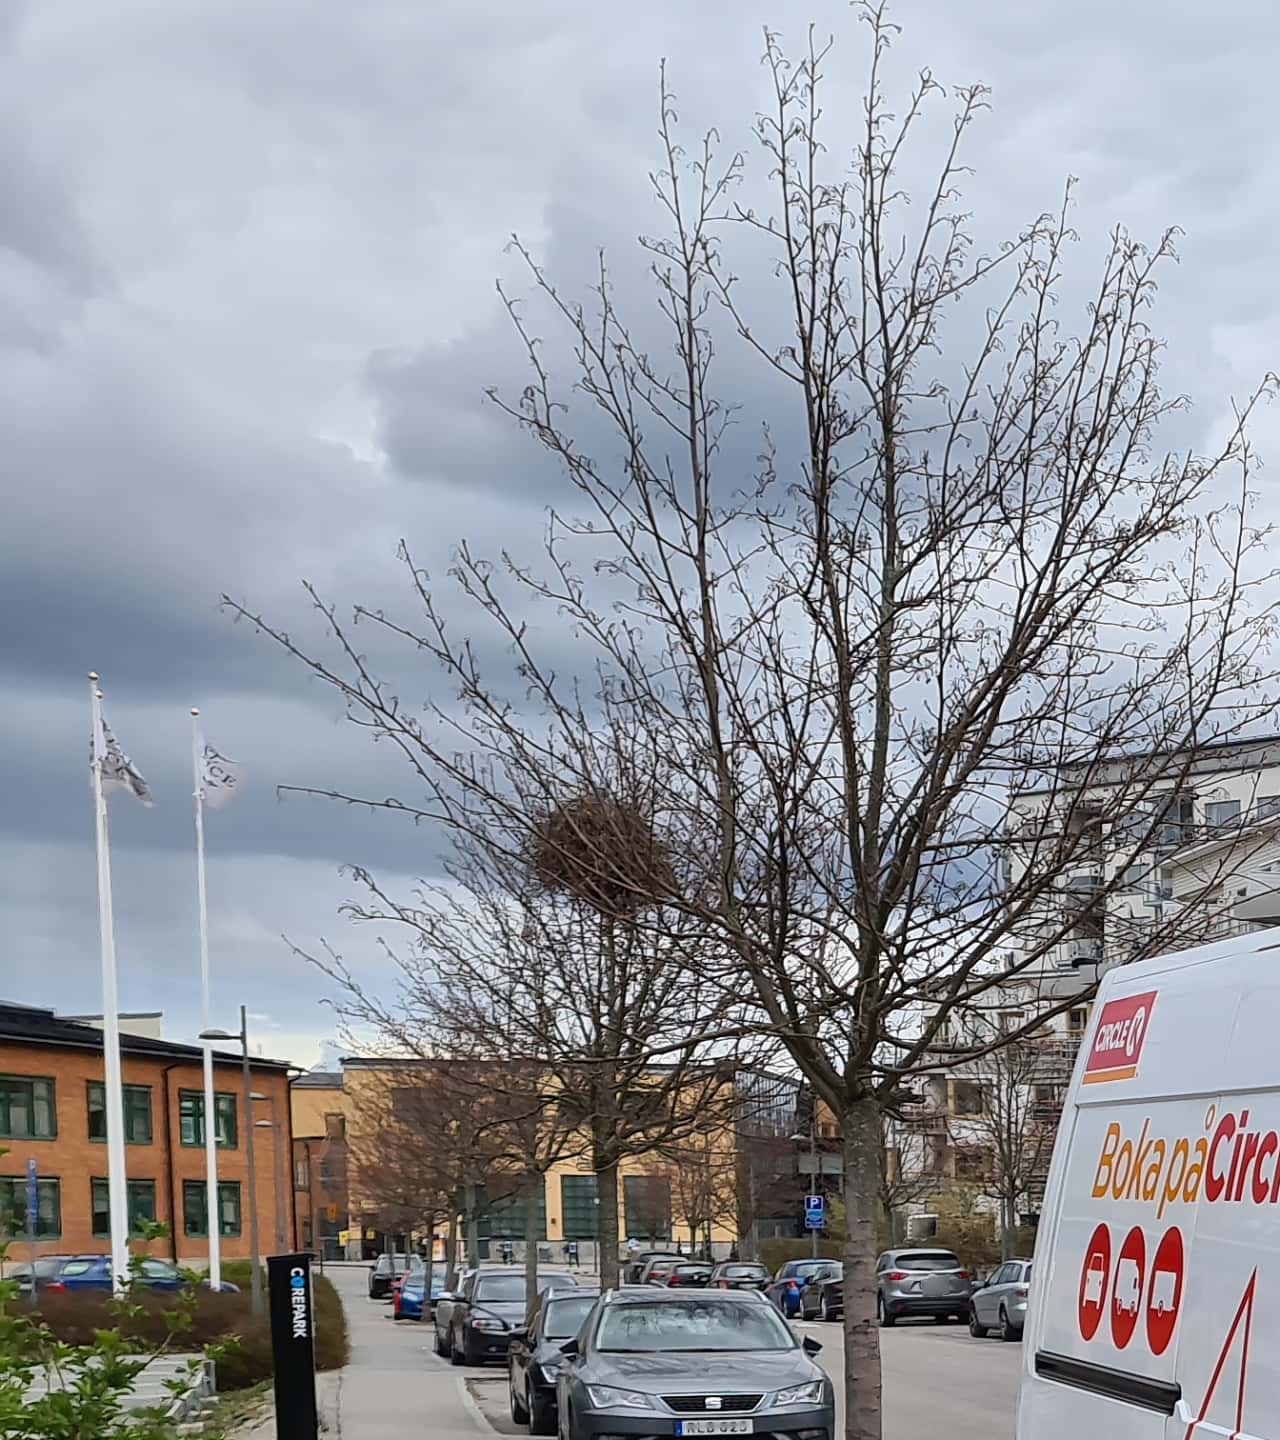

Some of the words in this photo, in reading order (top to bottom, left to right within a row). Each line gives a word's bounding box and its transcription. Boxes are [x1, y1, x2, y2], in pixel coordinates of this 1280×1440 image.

[1094, 1019, 1131, 1052] CIRCLE
[1092, 1117, 1165, 1200] Boka
[1156, 1103, 1216, 1220] på
[810, 1198, 820, 1209] P
[290, 1267, 308, 1338] COREPARK
